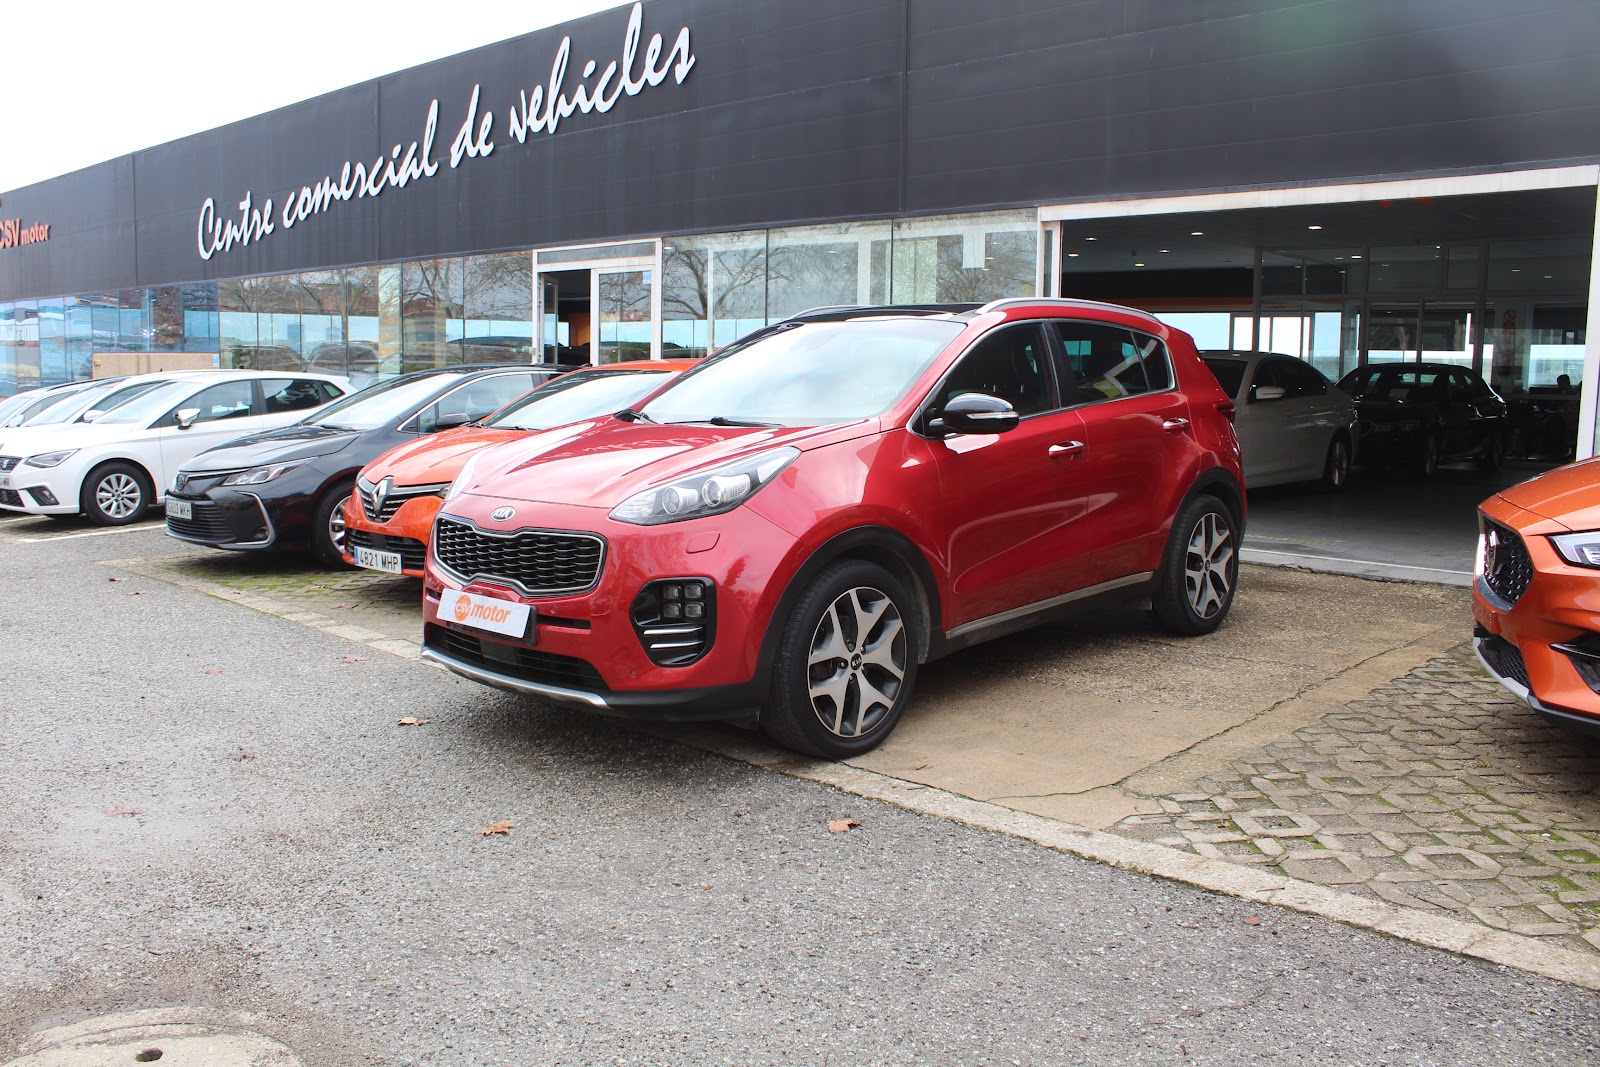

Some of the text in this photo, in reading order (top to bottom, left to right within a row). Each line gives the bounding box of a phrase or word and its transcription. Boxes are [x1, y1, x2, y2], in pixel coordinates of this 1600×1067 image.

[198, 2, 696, 261] Centre comercial de vehicles
[20, 221, 49, 245] motor
[360, 550, 399, 571] 4821 MHP
[455, 602, 512, 624] CSV motor
